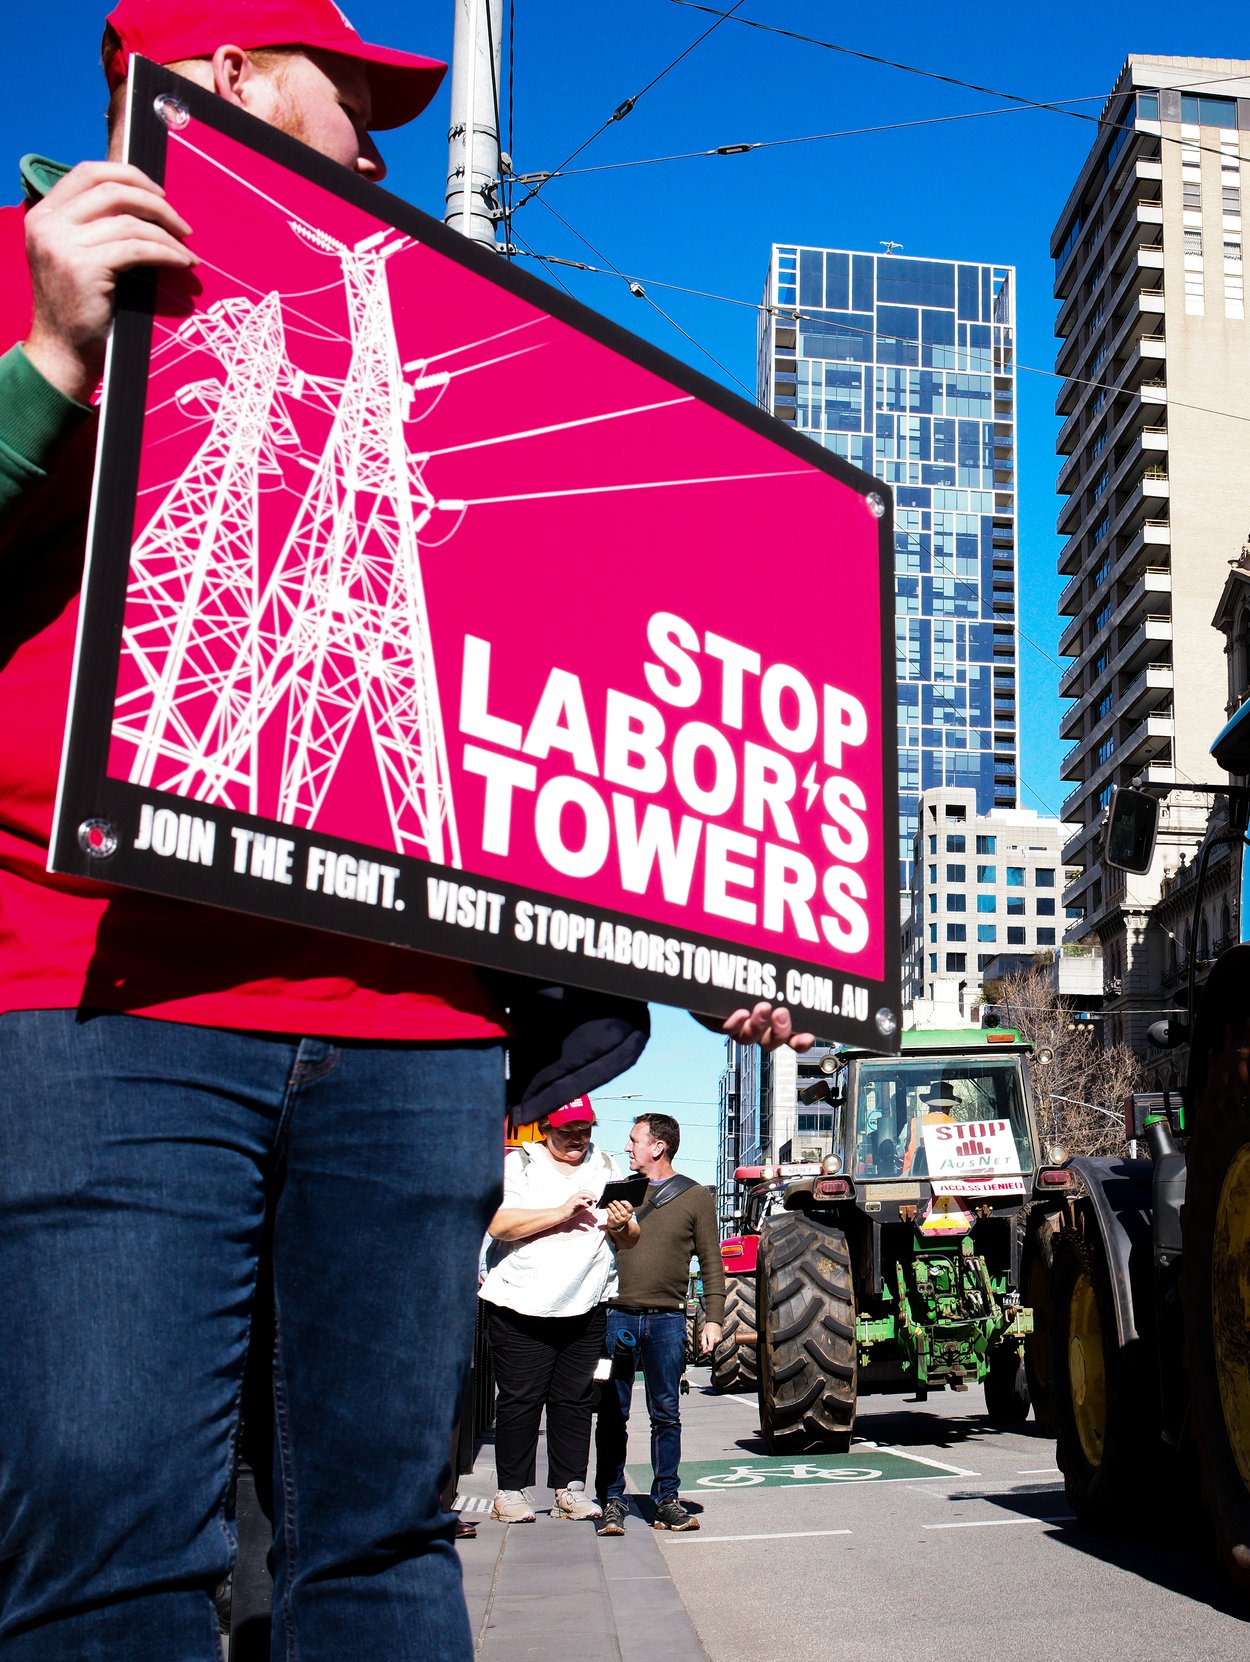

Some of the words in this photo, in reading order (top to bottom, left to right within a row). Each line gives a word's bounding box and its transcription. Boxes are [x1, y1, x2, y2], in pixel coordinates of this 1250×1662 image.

[644, 612, 867, 769] STOP
[134, 804, 216, 866] JOIN
[231, 827, 295, 885] THE
[306, 847, 405, 912] FIGHT.
[427, 877, 506, 934] VISIT
[515, 901, 869, 1022] STOPLABORSTOWERS.COM.AU
[462, 743, 869, 953] TOWERS
[935, 1122, 1006, 1141] STOP
[940, 1184, 981, 1192] ACCESS
[984, 1182, 1023, 1190] DENIED
